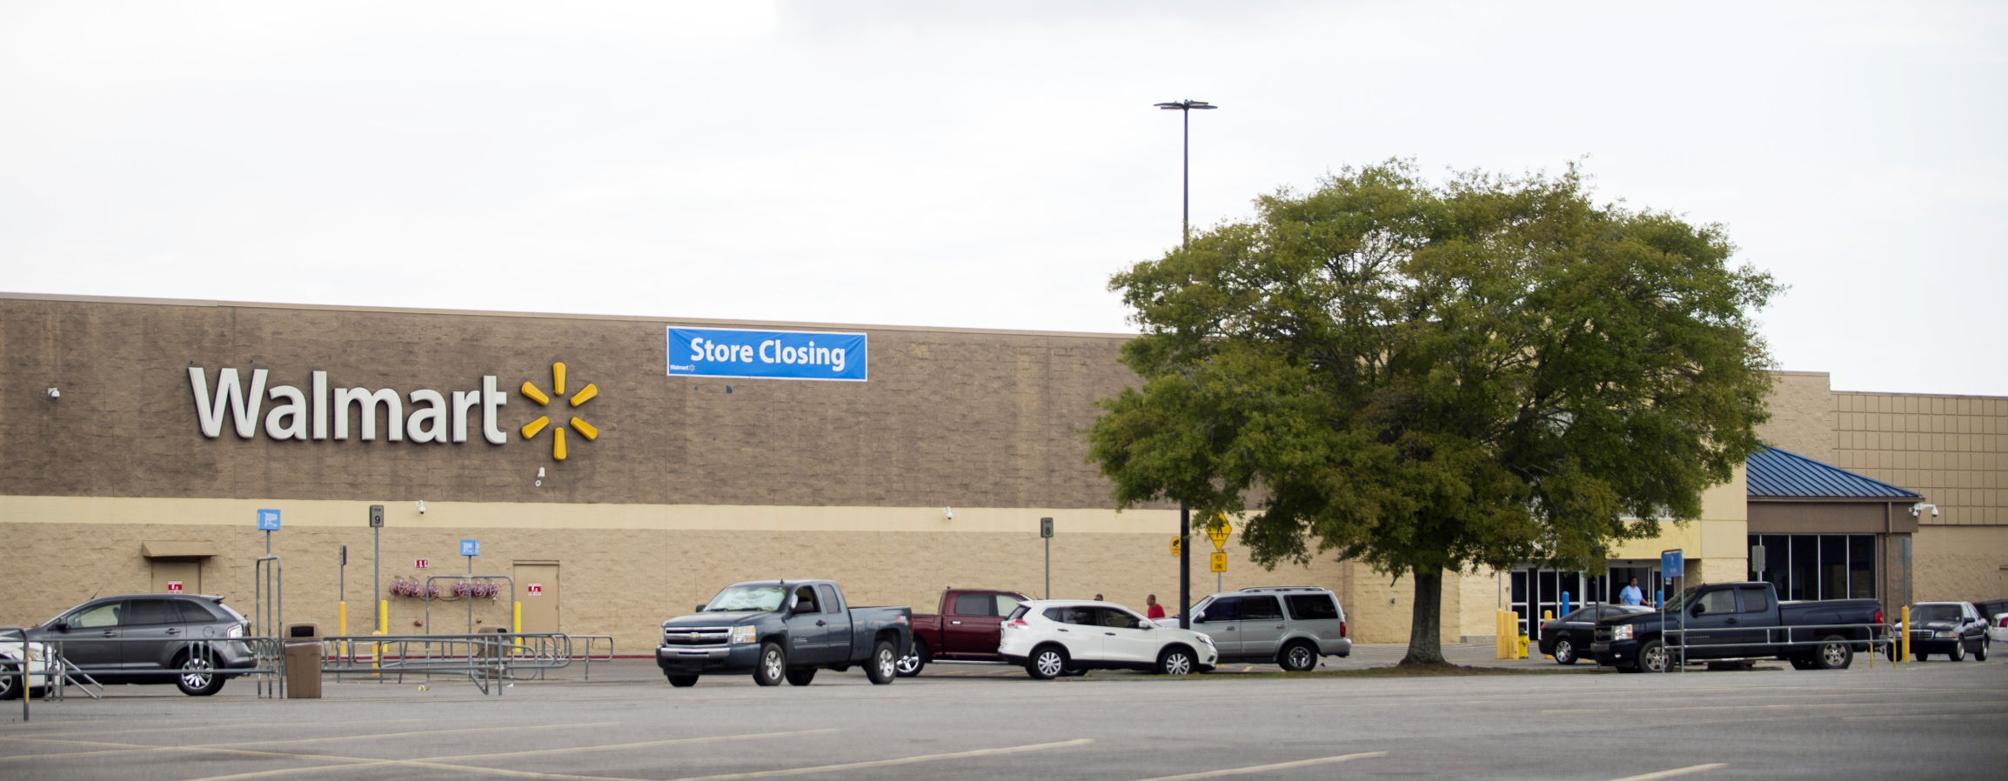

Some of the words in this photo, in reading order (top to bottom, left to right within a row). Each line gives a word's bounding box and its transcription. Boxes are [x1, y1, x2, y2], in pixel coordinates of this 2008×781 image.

[690, 337, 754, 362] Store
[759, 339, 846, 372] Closing
[188, 366, 507, 444] Walmart
[374, 515, 381, 525] 9
